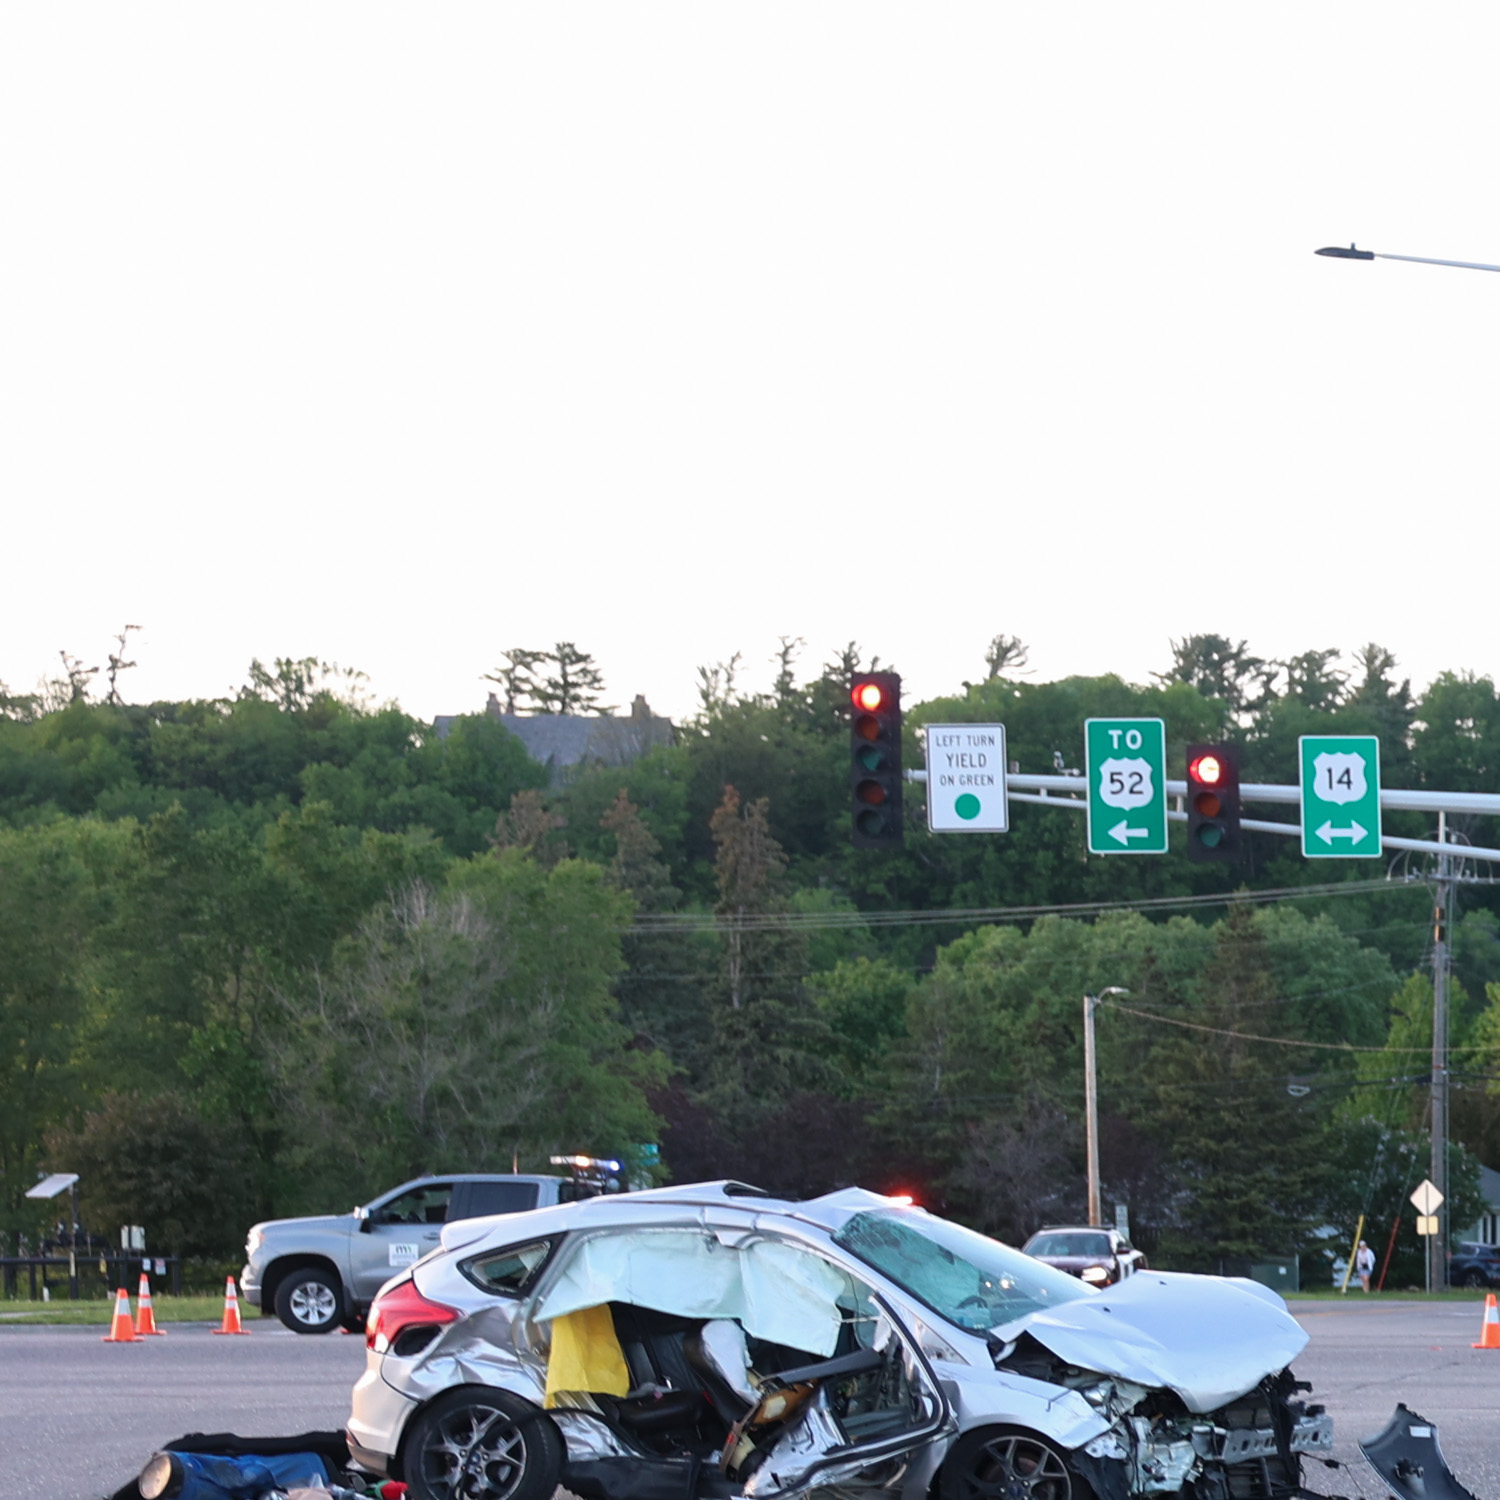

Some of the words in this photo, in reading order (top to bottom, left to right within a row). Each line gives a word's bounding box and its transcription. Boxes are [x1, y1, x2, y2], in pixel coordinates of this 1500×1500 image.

[936, 735, 961, 747] LEFT
[967, 735, 995, 747] TURN
[1108, 729, 1142, 750] TO
[946, 753, 987, 768] YIELD
[940, 774, 955, 786] ON
[959, 774, 995, 786] GREEN
[1110, 771, 1144, 795] 52
[1326, 767, 1353, 791] 14
